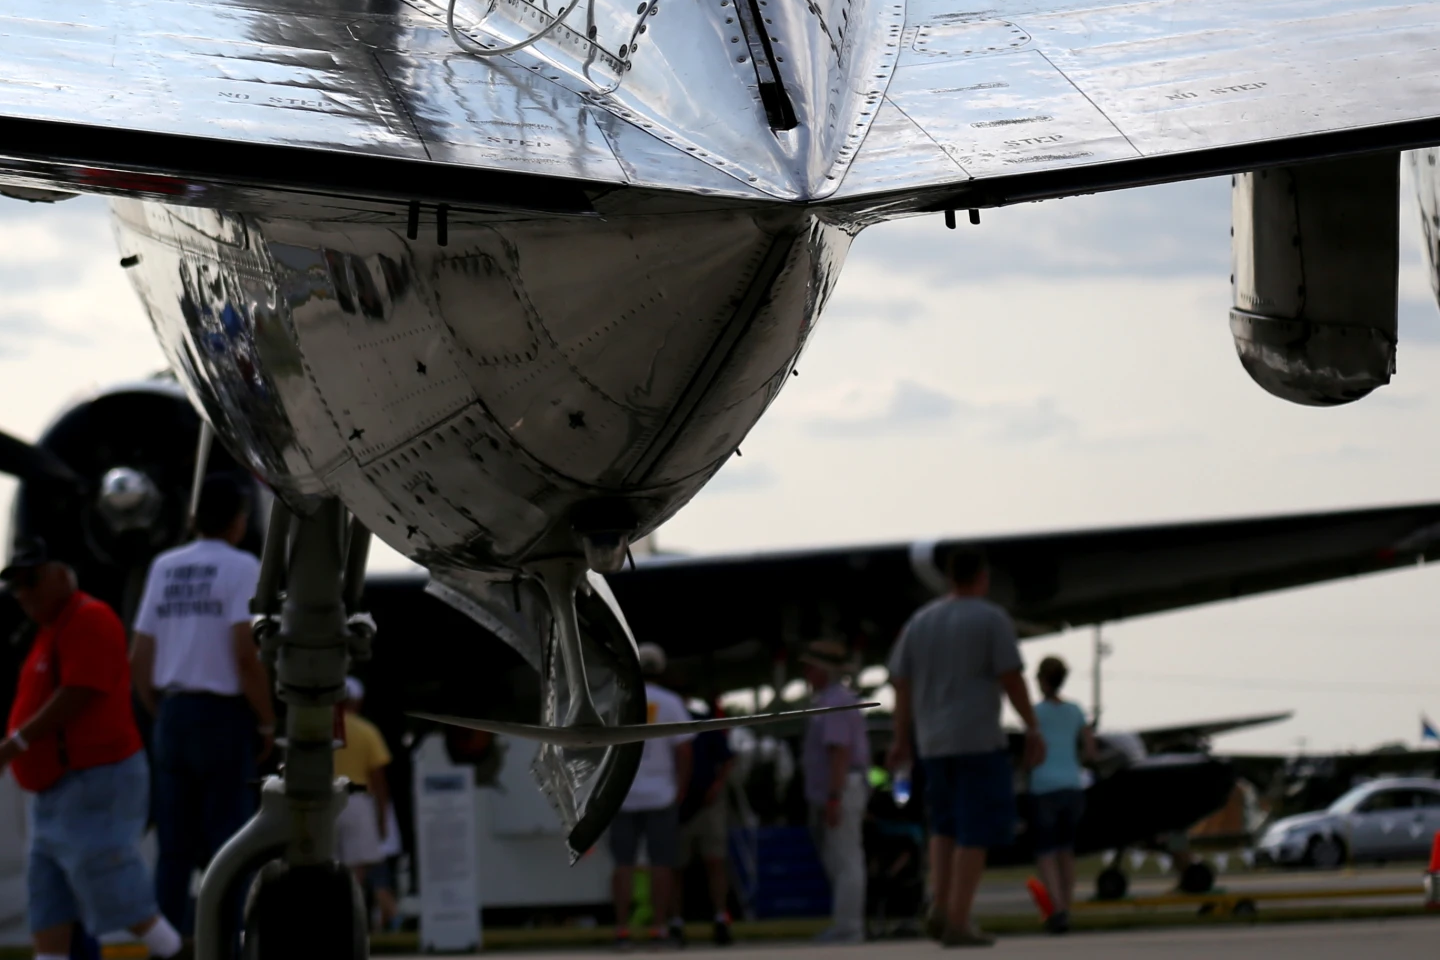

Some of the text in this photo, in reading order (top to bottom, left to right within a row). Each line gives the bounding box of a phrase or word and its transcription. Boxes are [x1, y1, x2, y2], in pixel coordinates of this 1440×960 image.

[1165, 81, 1268, 101] NO STEP
[217, 91, 333, 108] NO STEP
[486, 136, 552, 147] STEP
[1003, 134, 1064, 146] STEP
